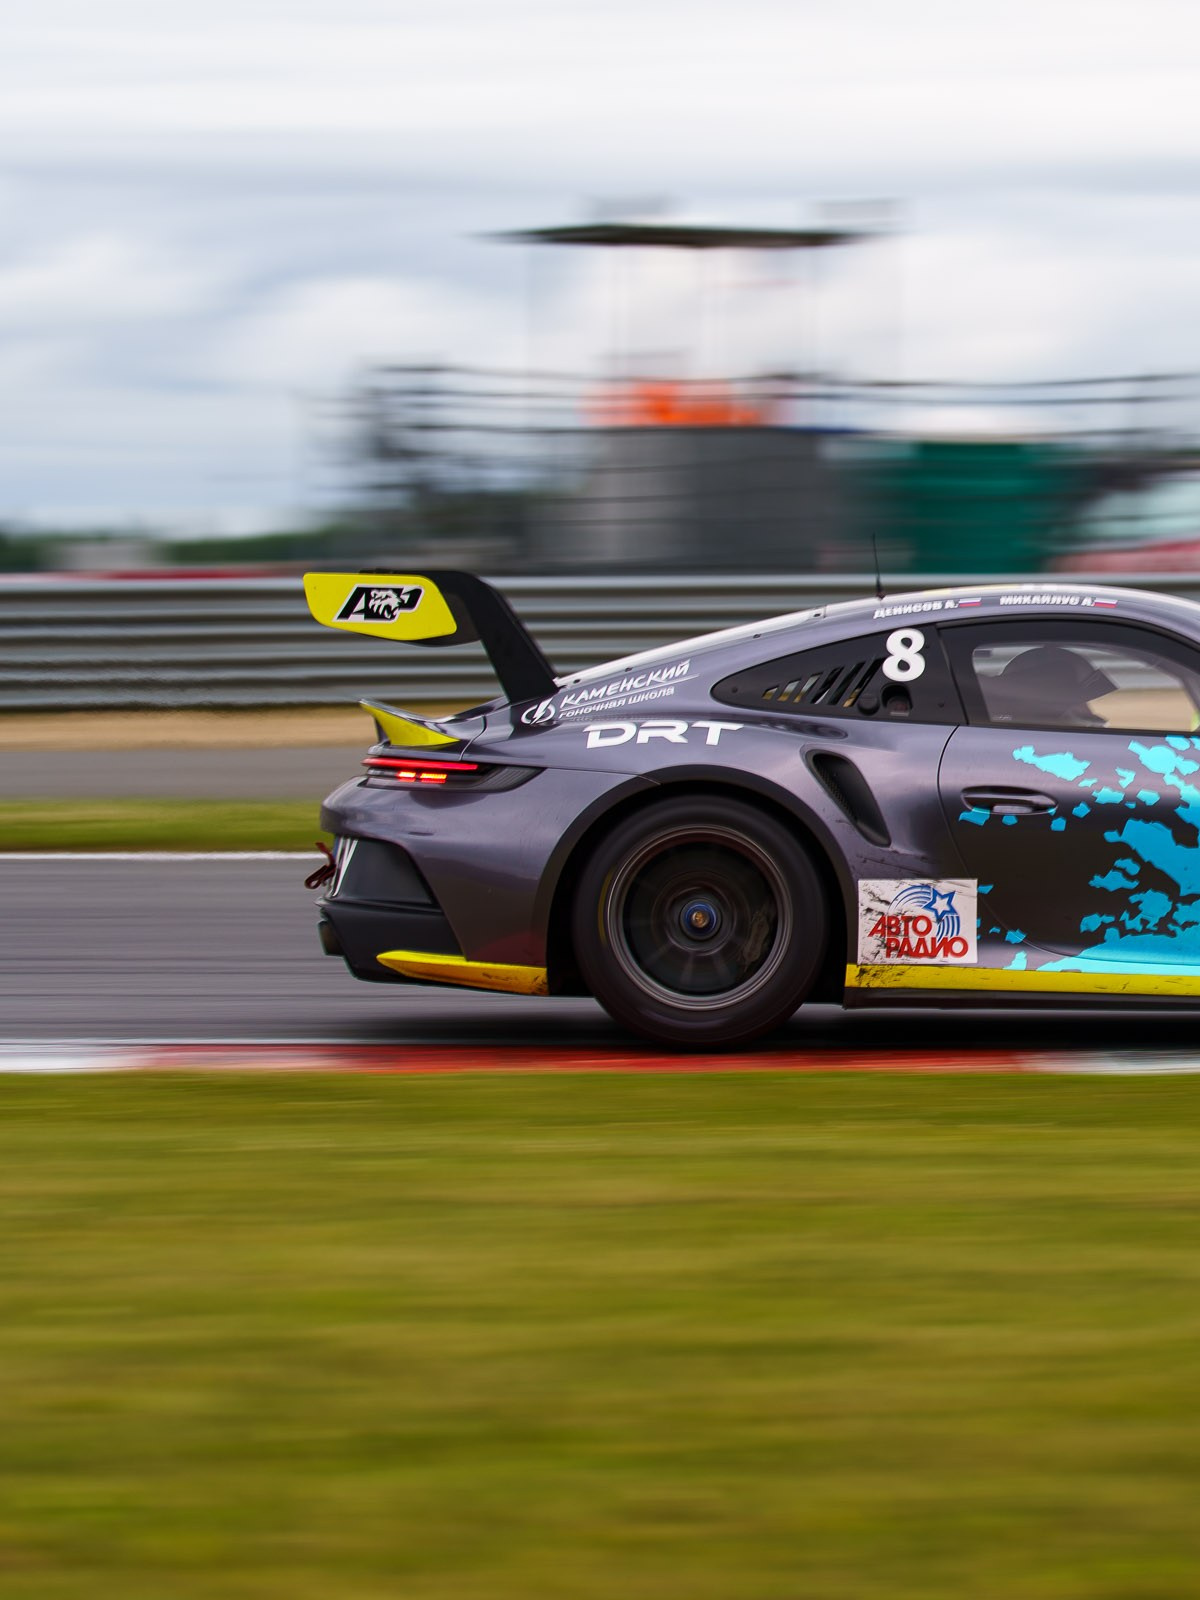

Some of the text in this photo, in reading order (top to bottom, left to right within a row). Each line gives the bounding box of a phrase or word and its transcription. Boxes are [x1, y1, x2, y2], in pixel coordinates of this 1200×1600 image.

[873, 600, 943, 620] ДЕНИСОВ
[882, 627, 926, 682] 8
[559, 659, 691, 709] КАМЕНСКИЙ
[582, 719, 745, 749] DRT
[867, 915, 933, 938] АВТО
[885, 936, 969, 959] РАДИО
